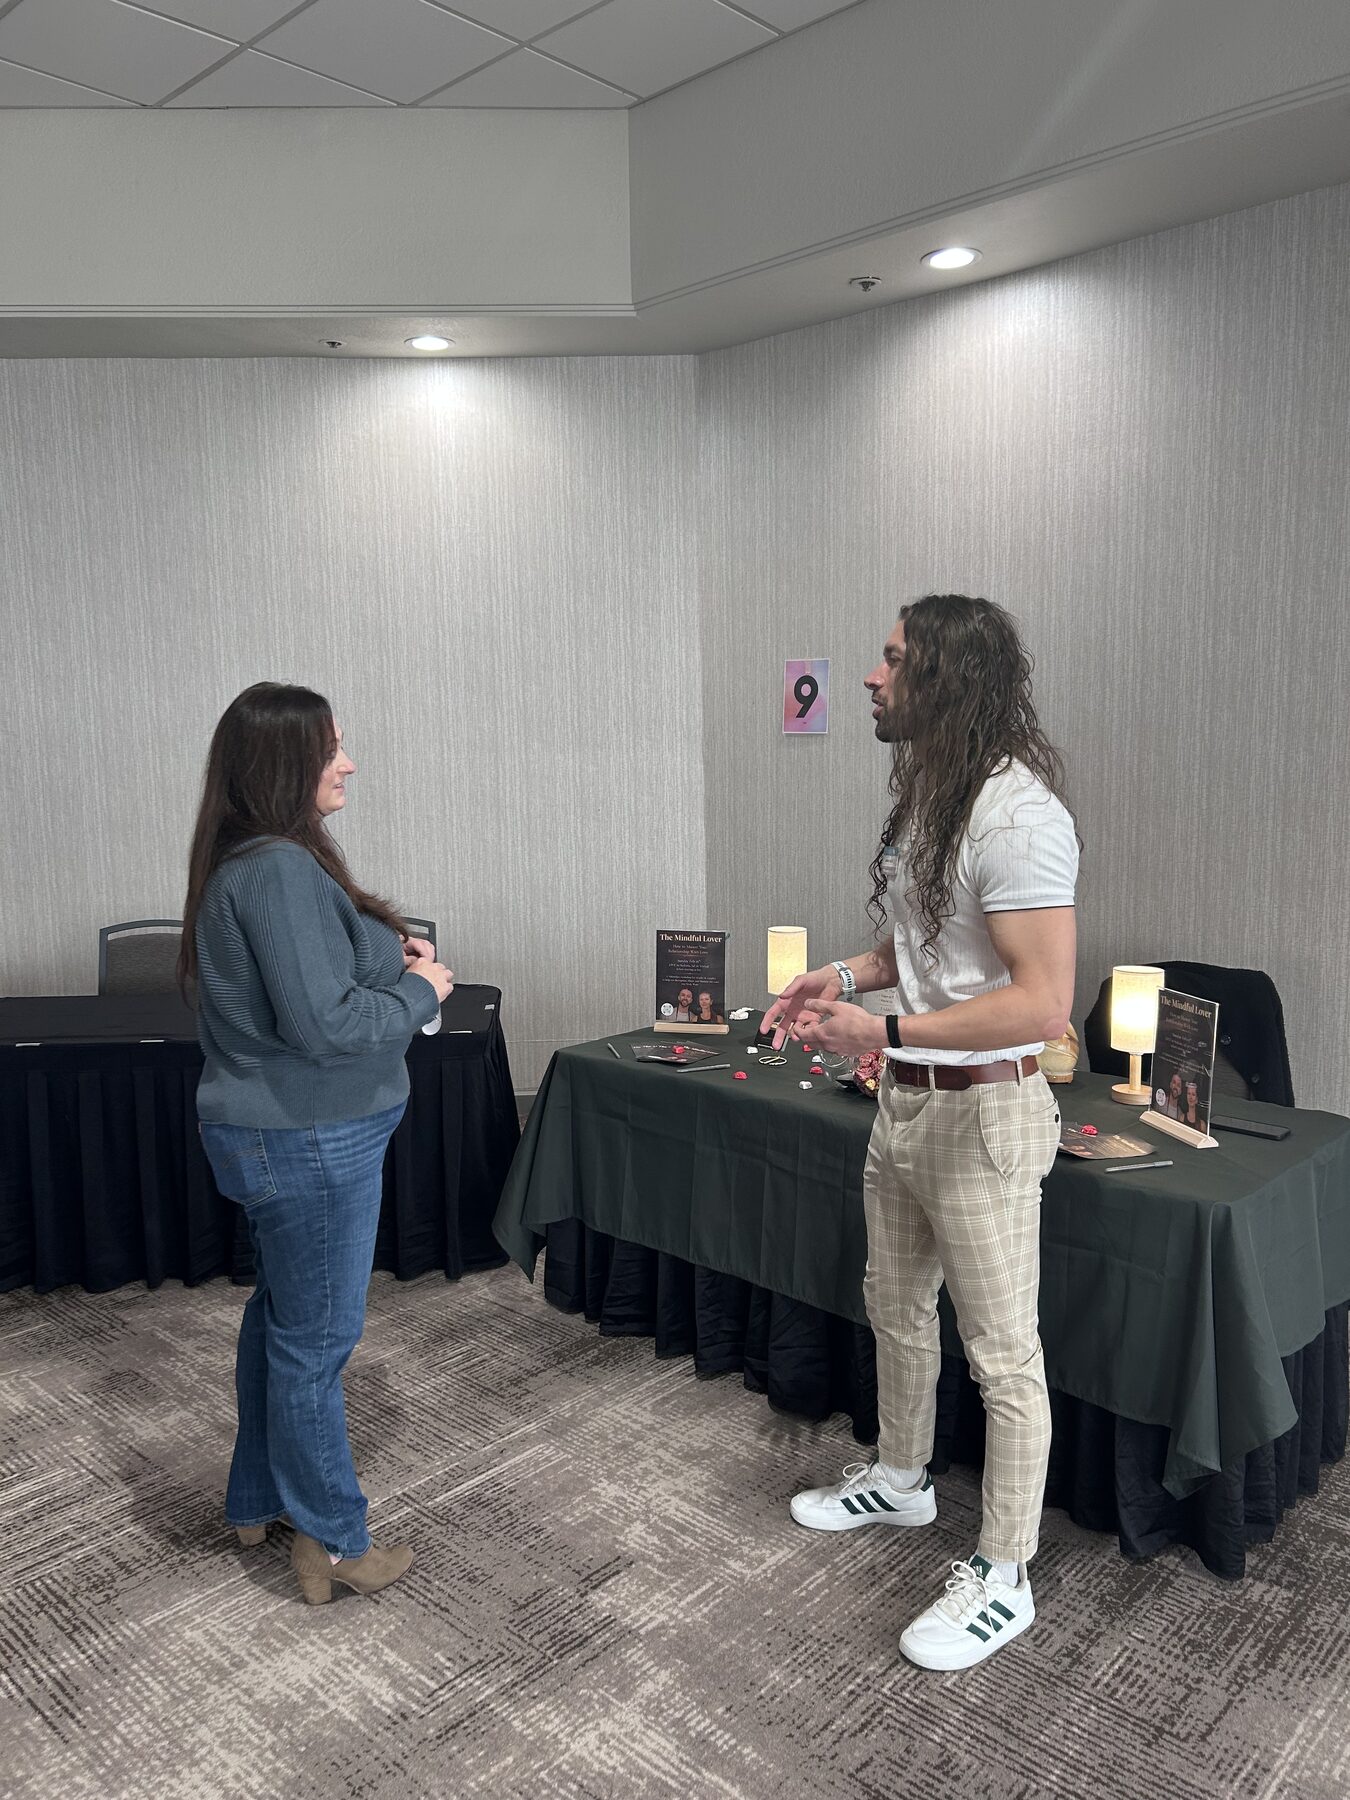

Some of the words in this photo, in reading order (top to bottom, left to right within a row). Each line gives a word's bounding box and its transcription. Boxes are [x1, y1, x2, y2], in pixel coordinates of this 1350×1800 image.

[794, 675, 818, 718] 9
[660, 933, 673, 941] The
[674, 934, 702, 942] Mindful
[703, 935, 722, 943] Lover
[1161, 995, 1171, 1006] The
[1171, 998, 1195, 1014] Mindful
[1195, 1005, 1212, 1019] Lover
